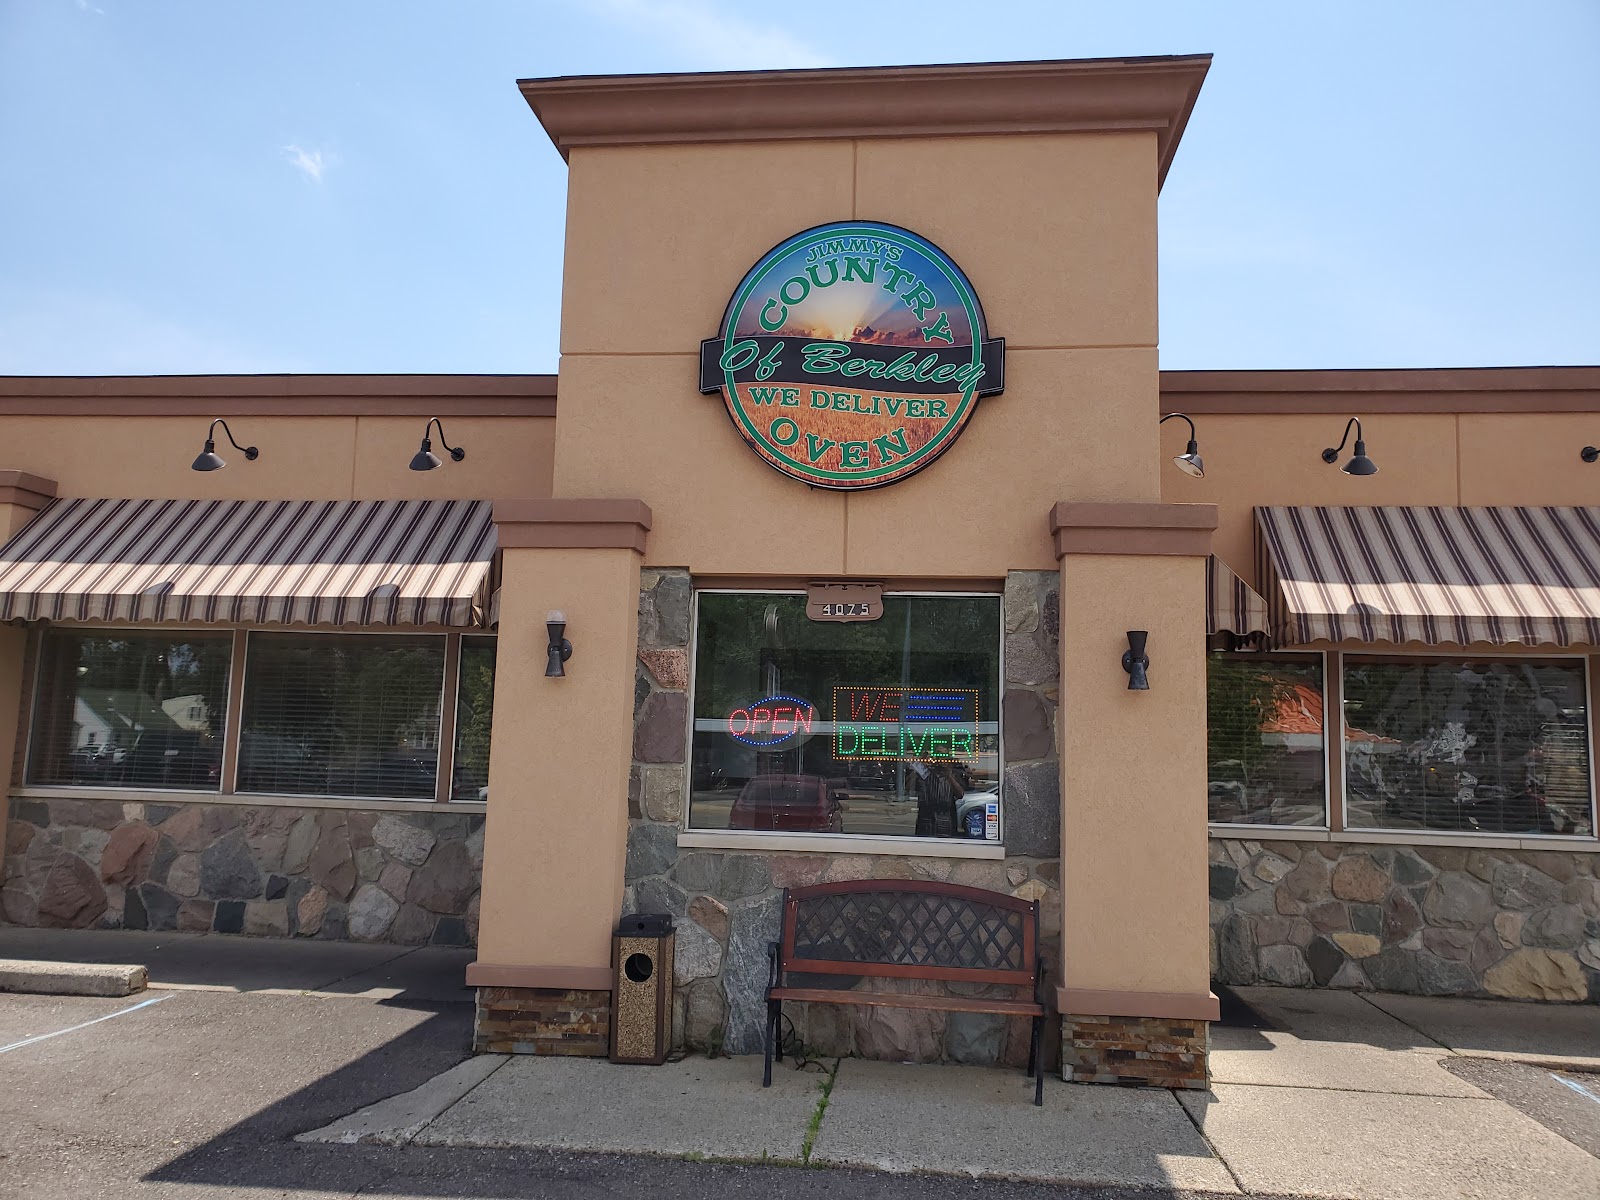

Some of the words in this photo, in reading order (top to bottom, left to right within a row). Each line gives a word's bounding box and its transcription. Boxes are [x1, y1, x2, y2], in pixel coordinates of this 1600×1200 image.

[805, 238, 904, 263] JIMMY'S
[758, 256, 955, 346] COUNTRY
[719, 340, 785, 382] Of
[801, 342, 986, 393] Berkley
[748, 386, 801, 408] WE
[809, 389, 950, 419] DELIVER
[769, 416, 912, 469] OVEN
[822, 603, 870, 616] 4075
[728, 706, 813, 736] OPEN
[850, 692, 903, 722] WE
[837, 725, 973, 758] DELIVER
